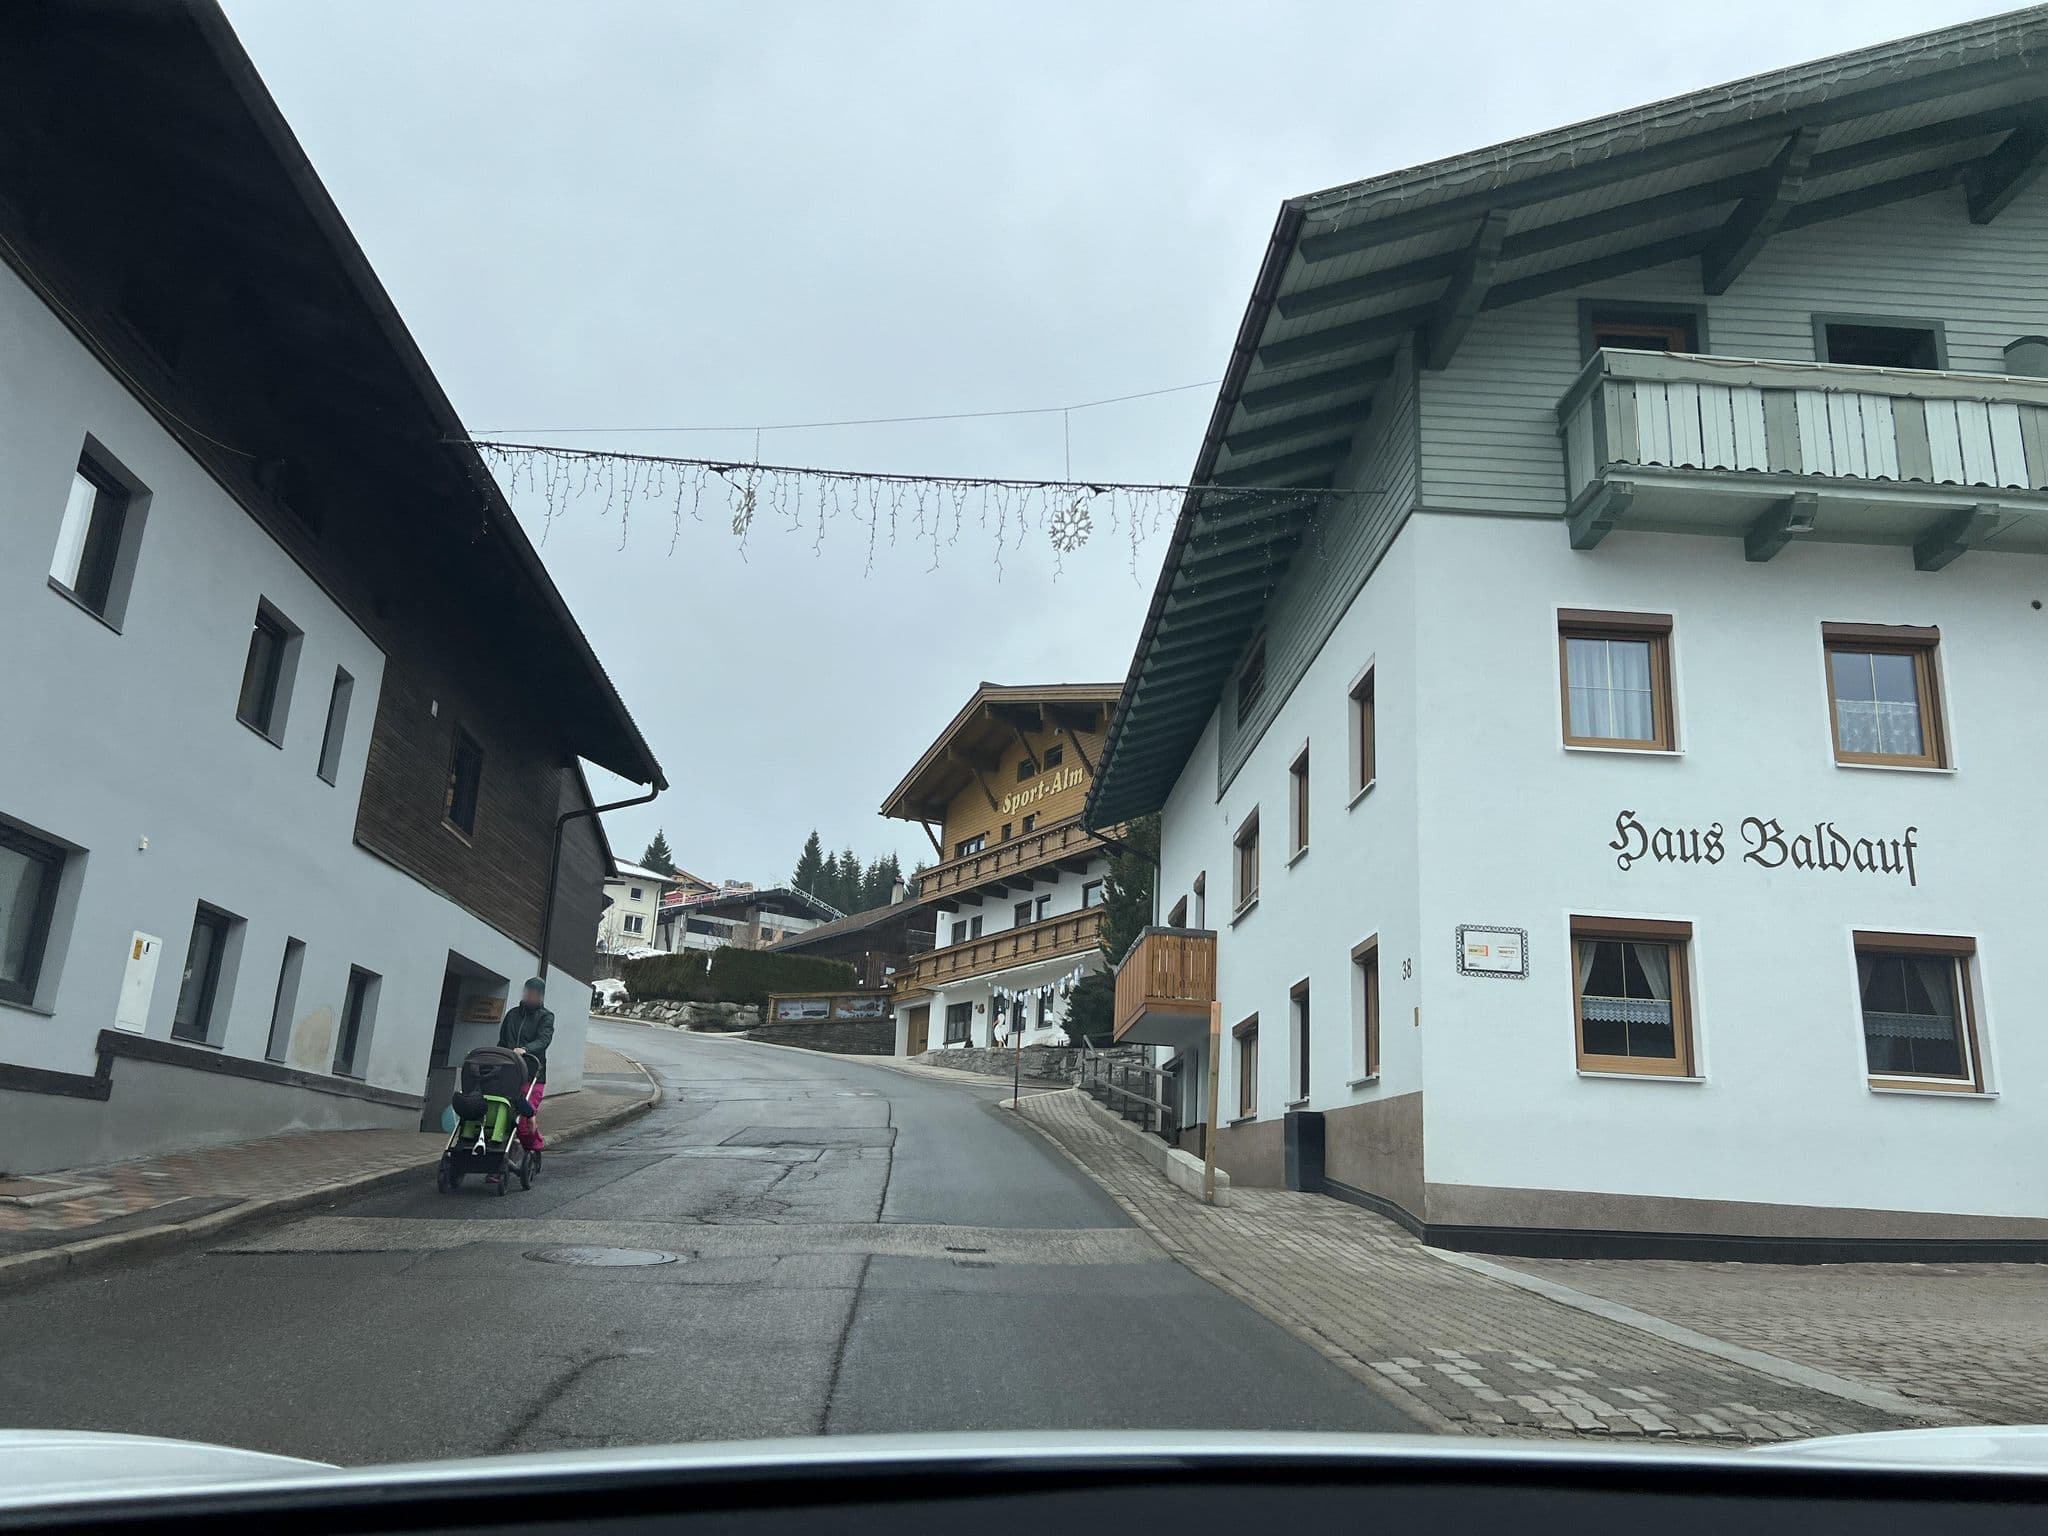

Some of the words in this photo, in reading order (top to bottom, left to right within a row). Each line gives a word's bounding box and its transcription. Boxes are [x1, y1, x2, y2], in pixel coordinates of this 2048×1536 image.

[1002, 767, 1084, 815] Sport-Alm
[1609, 810, 1725, 872] Haus
[1741, 816, 1919, 887] Baldauf
[1402, 958, 1412, 980] 38
